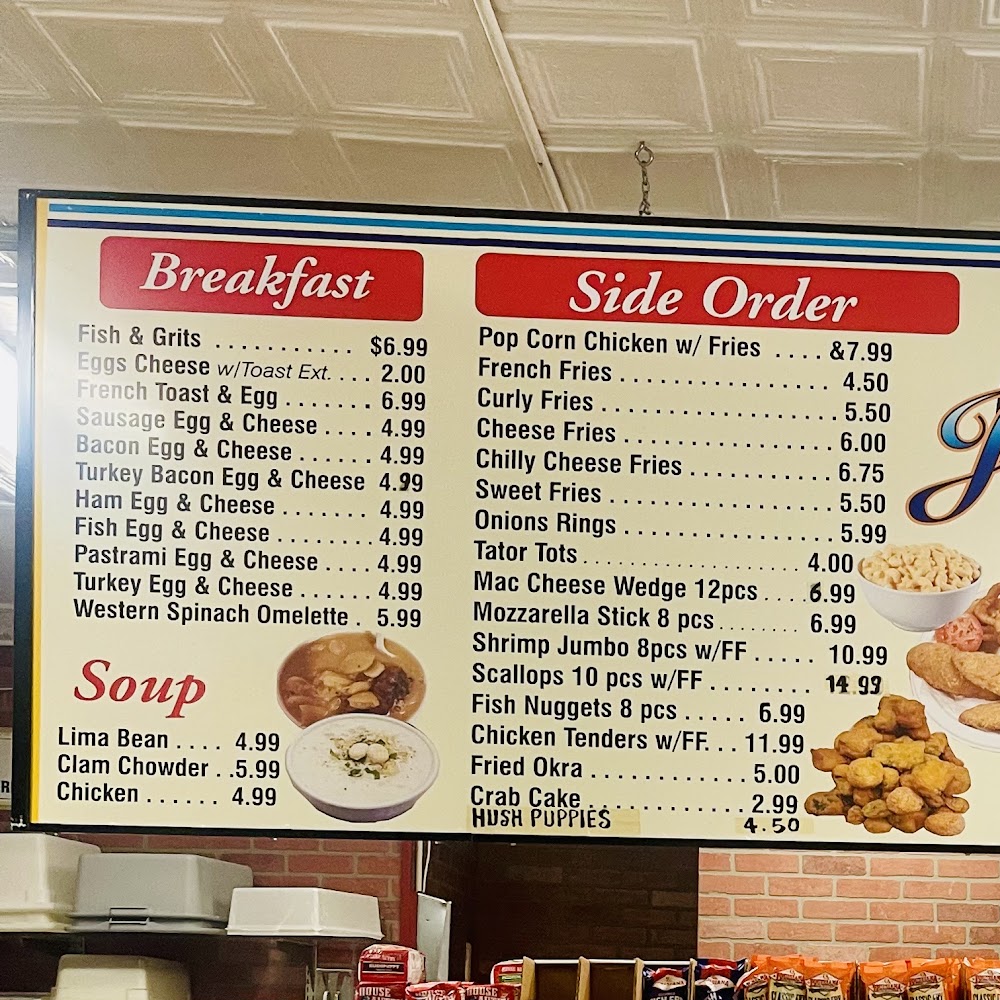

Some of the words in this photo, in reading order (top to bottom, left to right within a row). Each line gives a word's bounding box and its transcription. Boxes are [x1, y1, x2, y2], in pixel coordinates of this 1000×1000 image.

[139, 251, 374, 309] Breakfast
[569, 270, 683, 316] Side
[703, 275, 857, 324] Order
[78, 323, 120, 344] Fish
[129, 326, 144, 345] &
[153, 327, 201, 348] Grits
[370, 334, 428, 357] $6.99
[479, 326, 519, 352] Pop
[526, 328, 576, 350] Corn
[584, 330, 668, 354] Chicken
[675, 334, 702, 357] w/
[709, 335, 761, 357] Fries
[829, 340, 893, 363] &7.99
[78, 351, 127, 376] Eggs
[135, 353, 210, 376] Cheese
[217, 361, 293, 379] w/Toast
[381, 363, 426, 384] 2.00
[478, 356, 551, 379] French
[559, 360, 612, 382] Fries
[842, 371, 889, 393] 4.50
[73, 598, 159, 620] Western
[167, 601, 249, 626] Spinach
[257, 604, 349, 626] Omelette
[377, 608, 421, 628] 5.99
[473, 601, 589, 625] Mozzarella
[597, 605, 650, 627] Stick
[657, 607, 670, 628] 8
[678, 613, 714, 633] pcs
[810, 613, 856, 635] 6.99
[74, 659, 206, 718] Soup
[58, 726, 109, 747] Lima
[117, 728, 168, 749] Bean
[235, 732, 280, 752] 4.99
[471, 754, 525, 776] Fried
[533, 756, 583, 778] Okra
[754, 763, 800, 785] 5.00
[57, 781, 138, 803] Chicken
[231, 786, 277, 807] 4.99
[472, 808, 523, 828] HUSH
[531, 810, 611, 829] PUPPIES
[744, 818, 800, 833] 4.50
